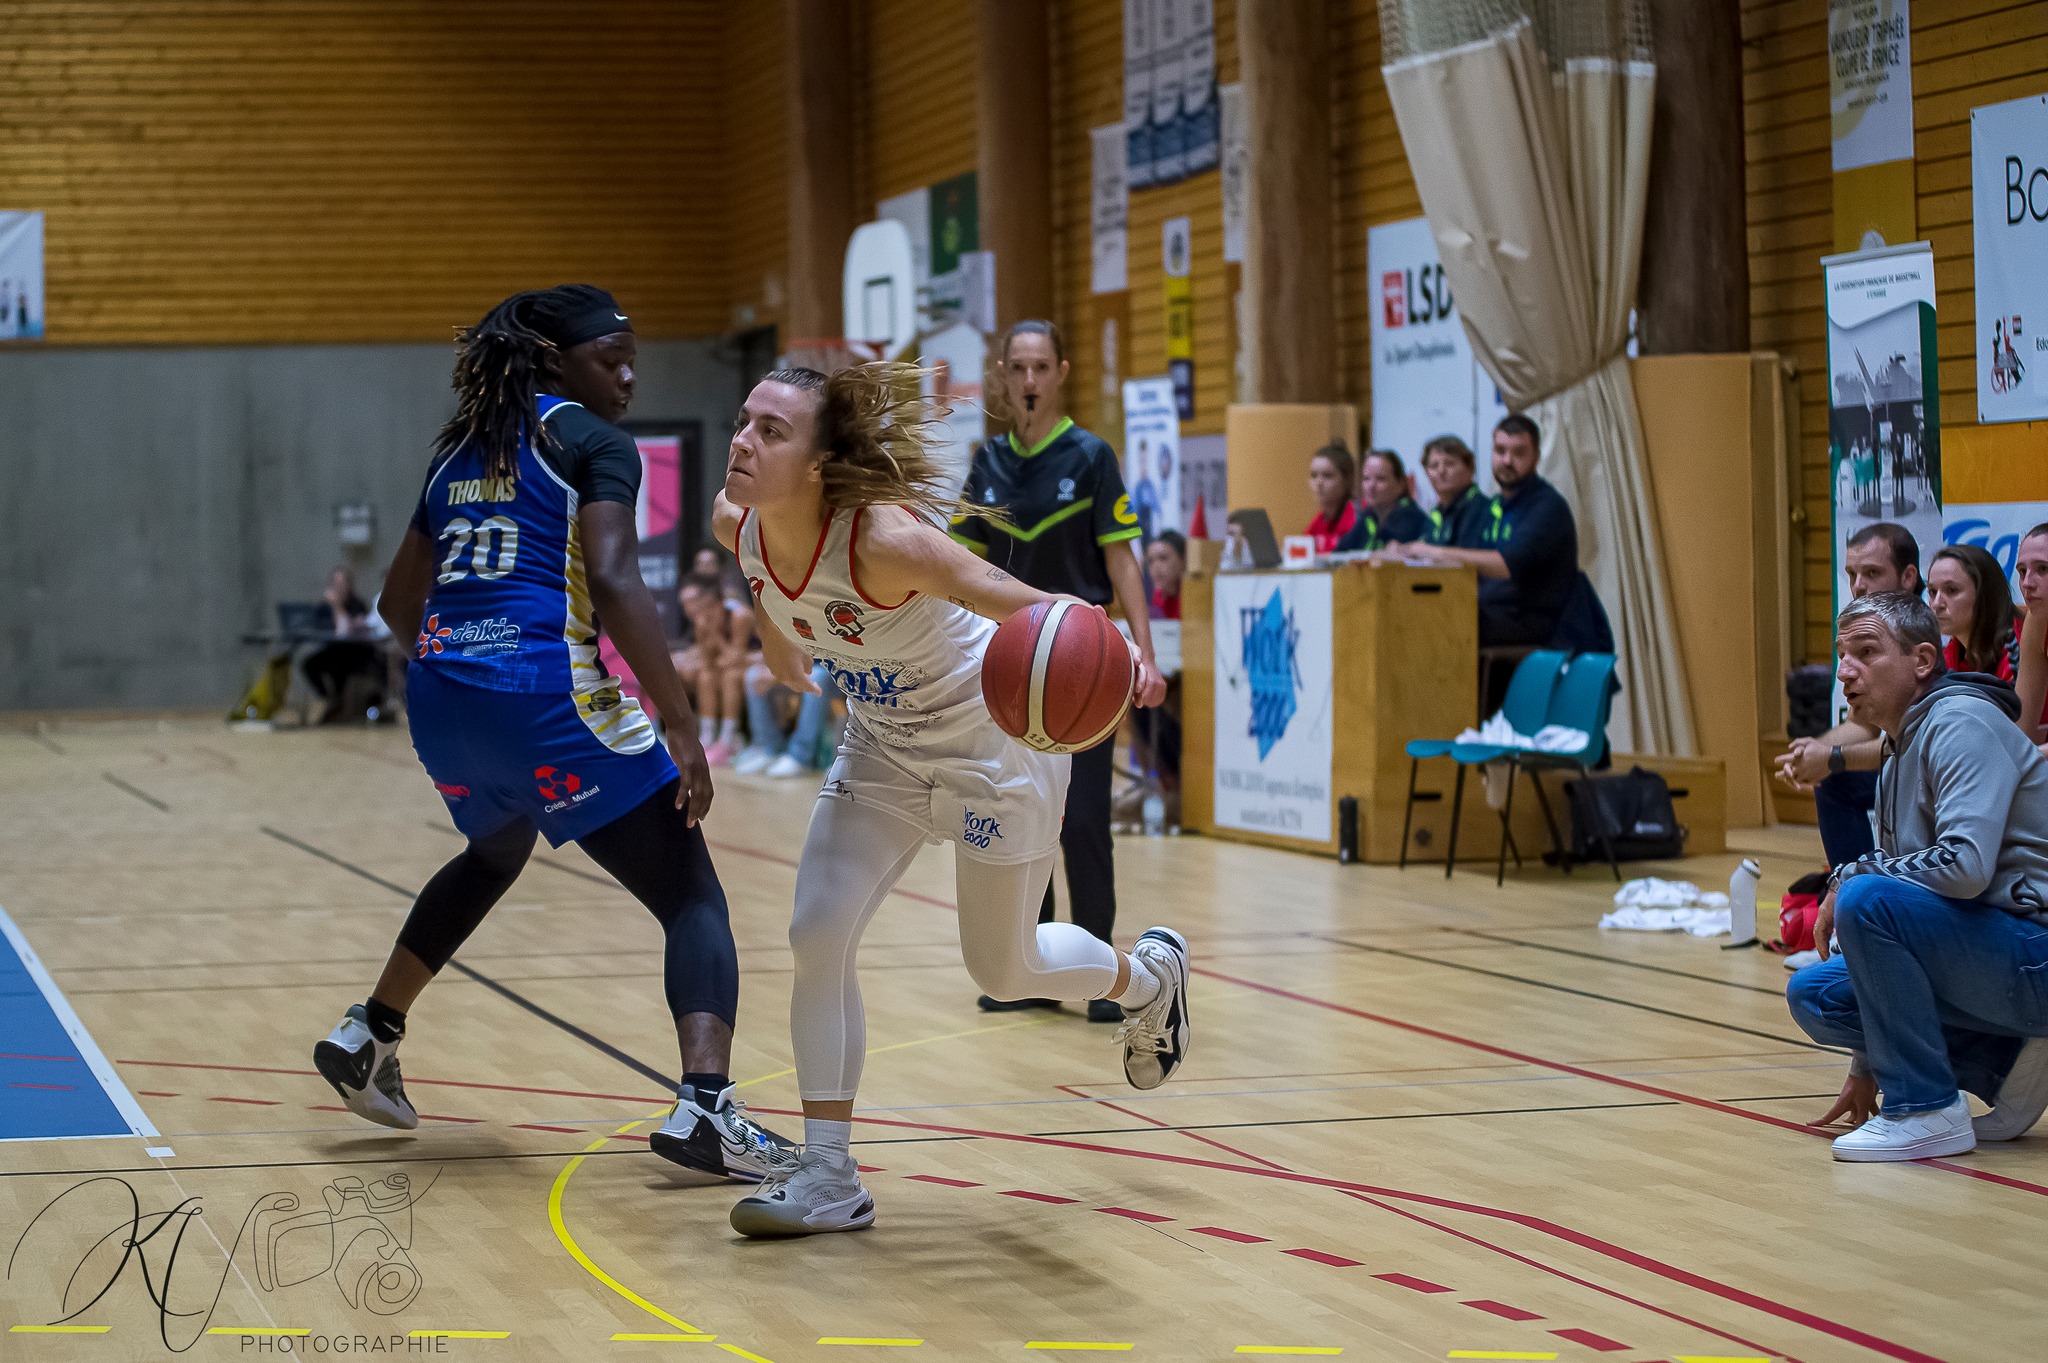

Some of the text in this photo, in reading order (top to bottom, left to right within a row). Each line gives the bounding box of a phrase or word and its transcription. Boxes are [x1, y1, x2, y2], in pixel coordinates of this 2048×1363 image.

[448, 476, 517, 506] THOMAS
[437, 515, 519, 585] 20
[449, 618, 520, 644] dalkia
[544, 801, 567, 814] Crédit
[572, 785, 600, 803] Mutuel
